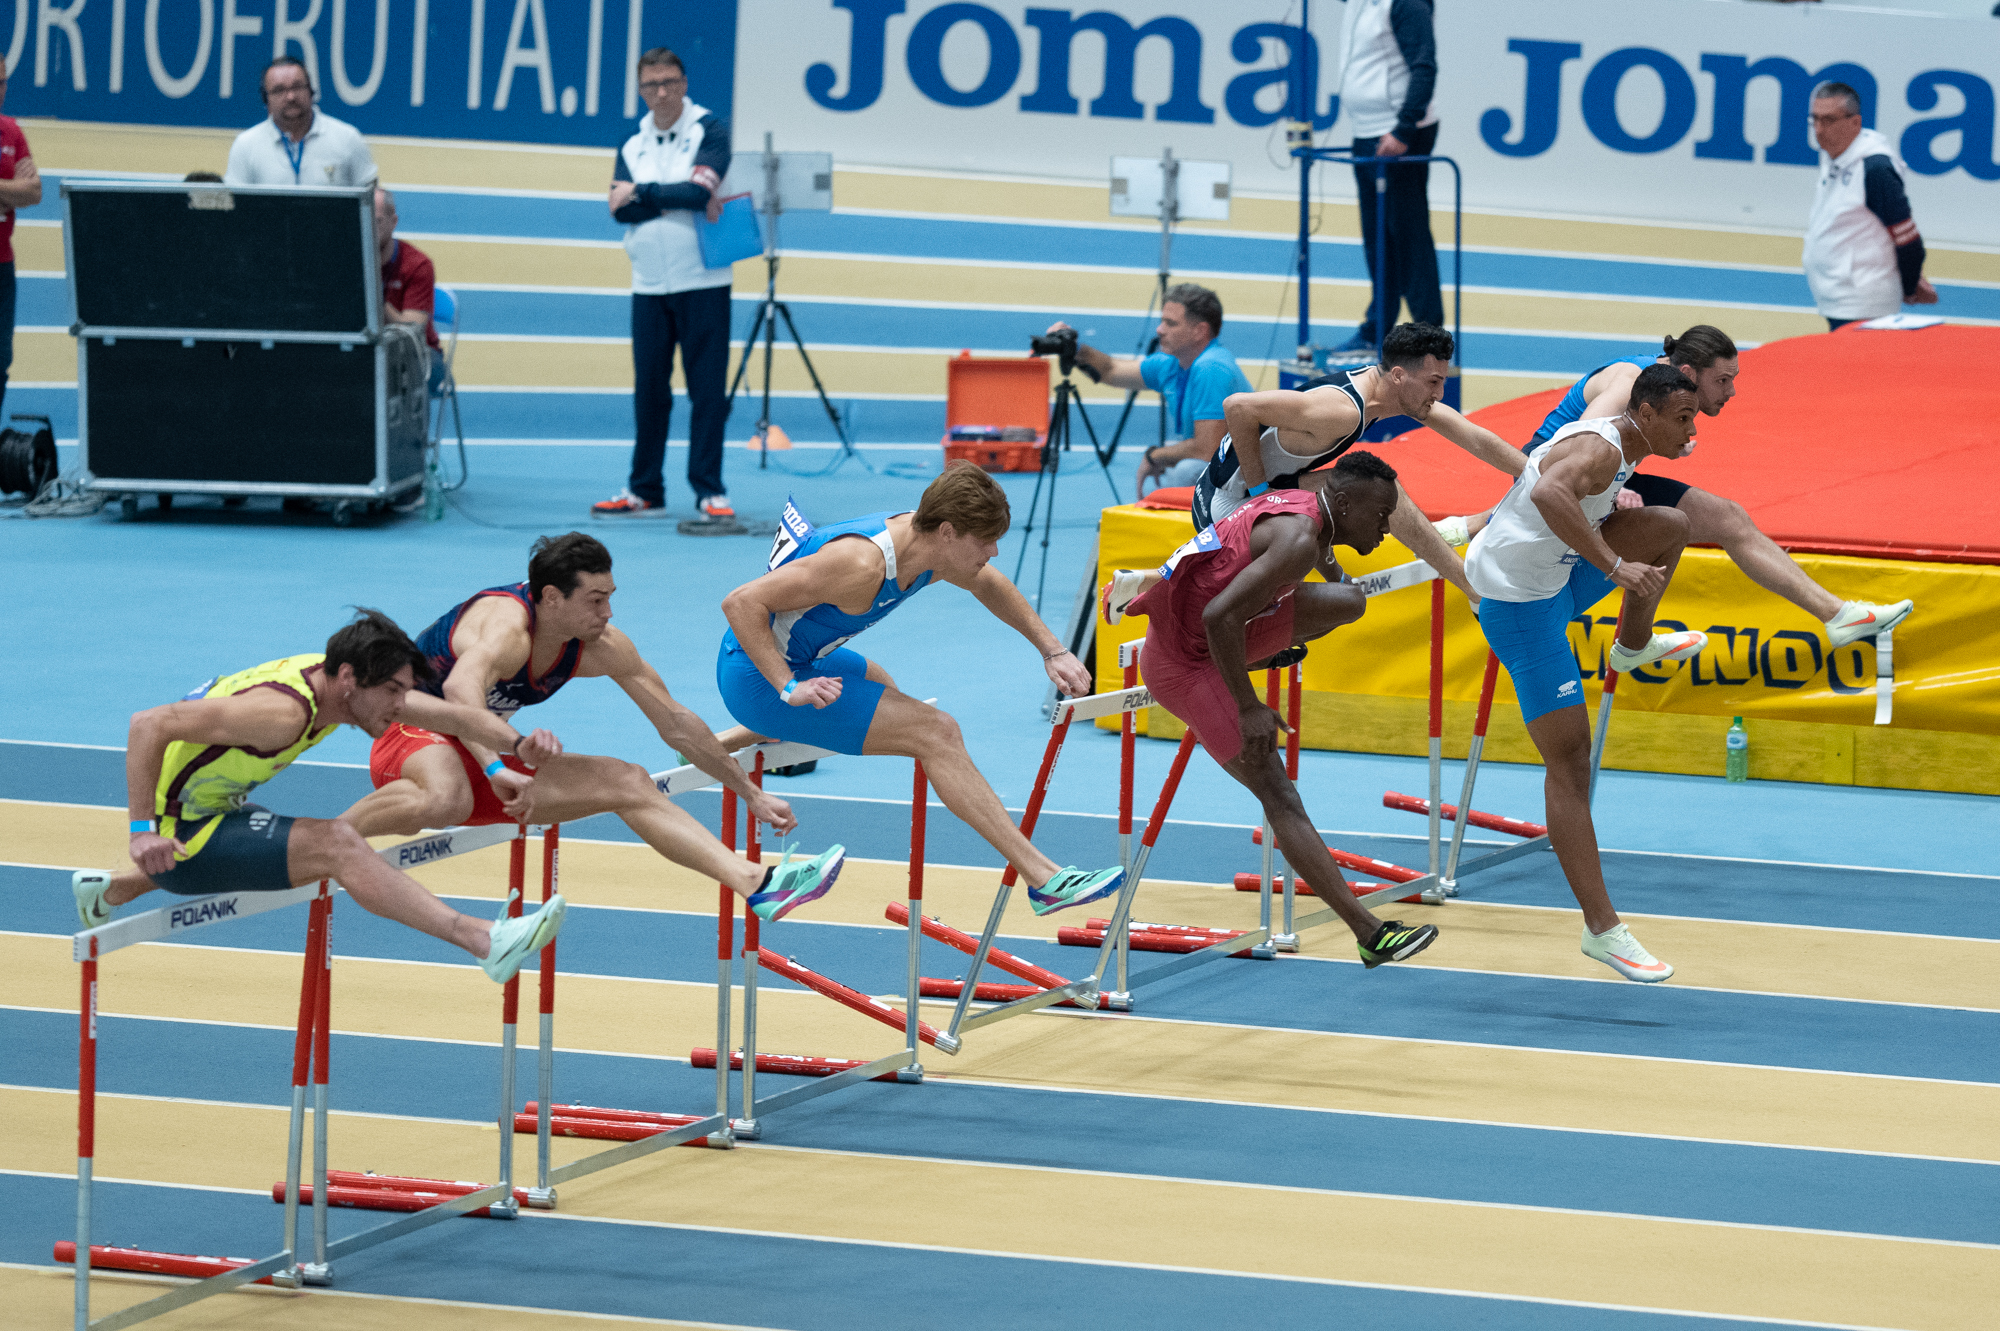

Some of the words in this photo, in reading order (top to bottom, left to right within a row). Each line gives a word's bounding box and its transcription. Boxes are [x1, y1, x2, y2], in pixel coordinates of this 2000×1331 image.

[803, 0, 1340, 132] Joma
[1479, 38, 2000, 181] Joma
[1556, 688, 1578, 699] KARHU
[400, 836, 453, 866] POLANIK
[170, 897, 239, 928] POLANIK
